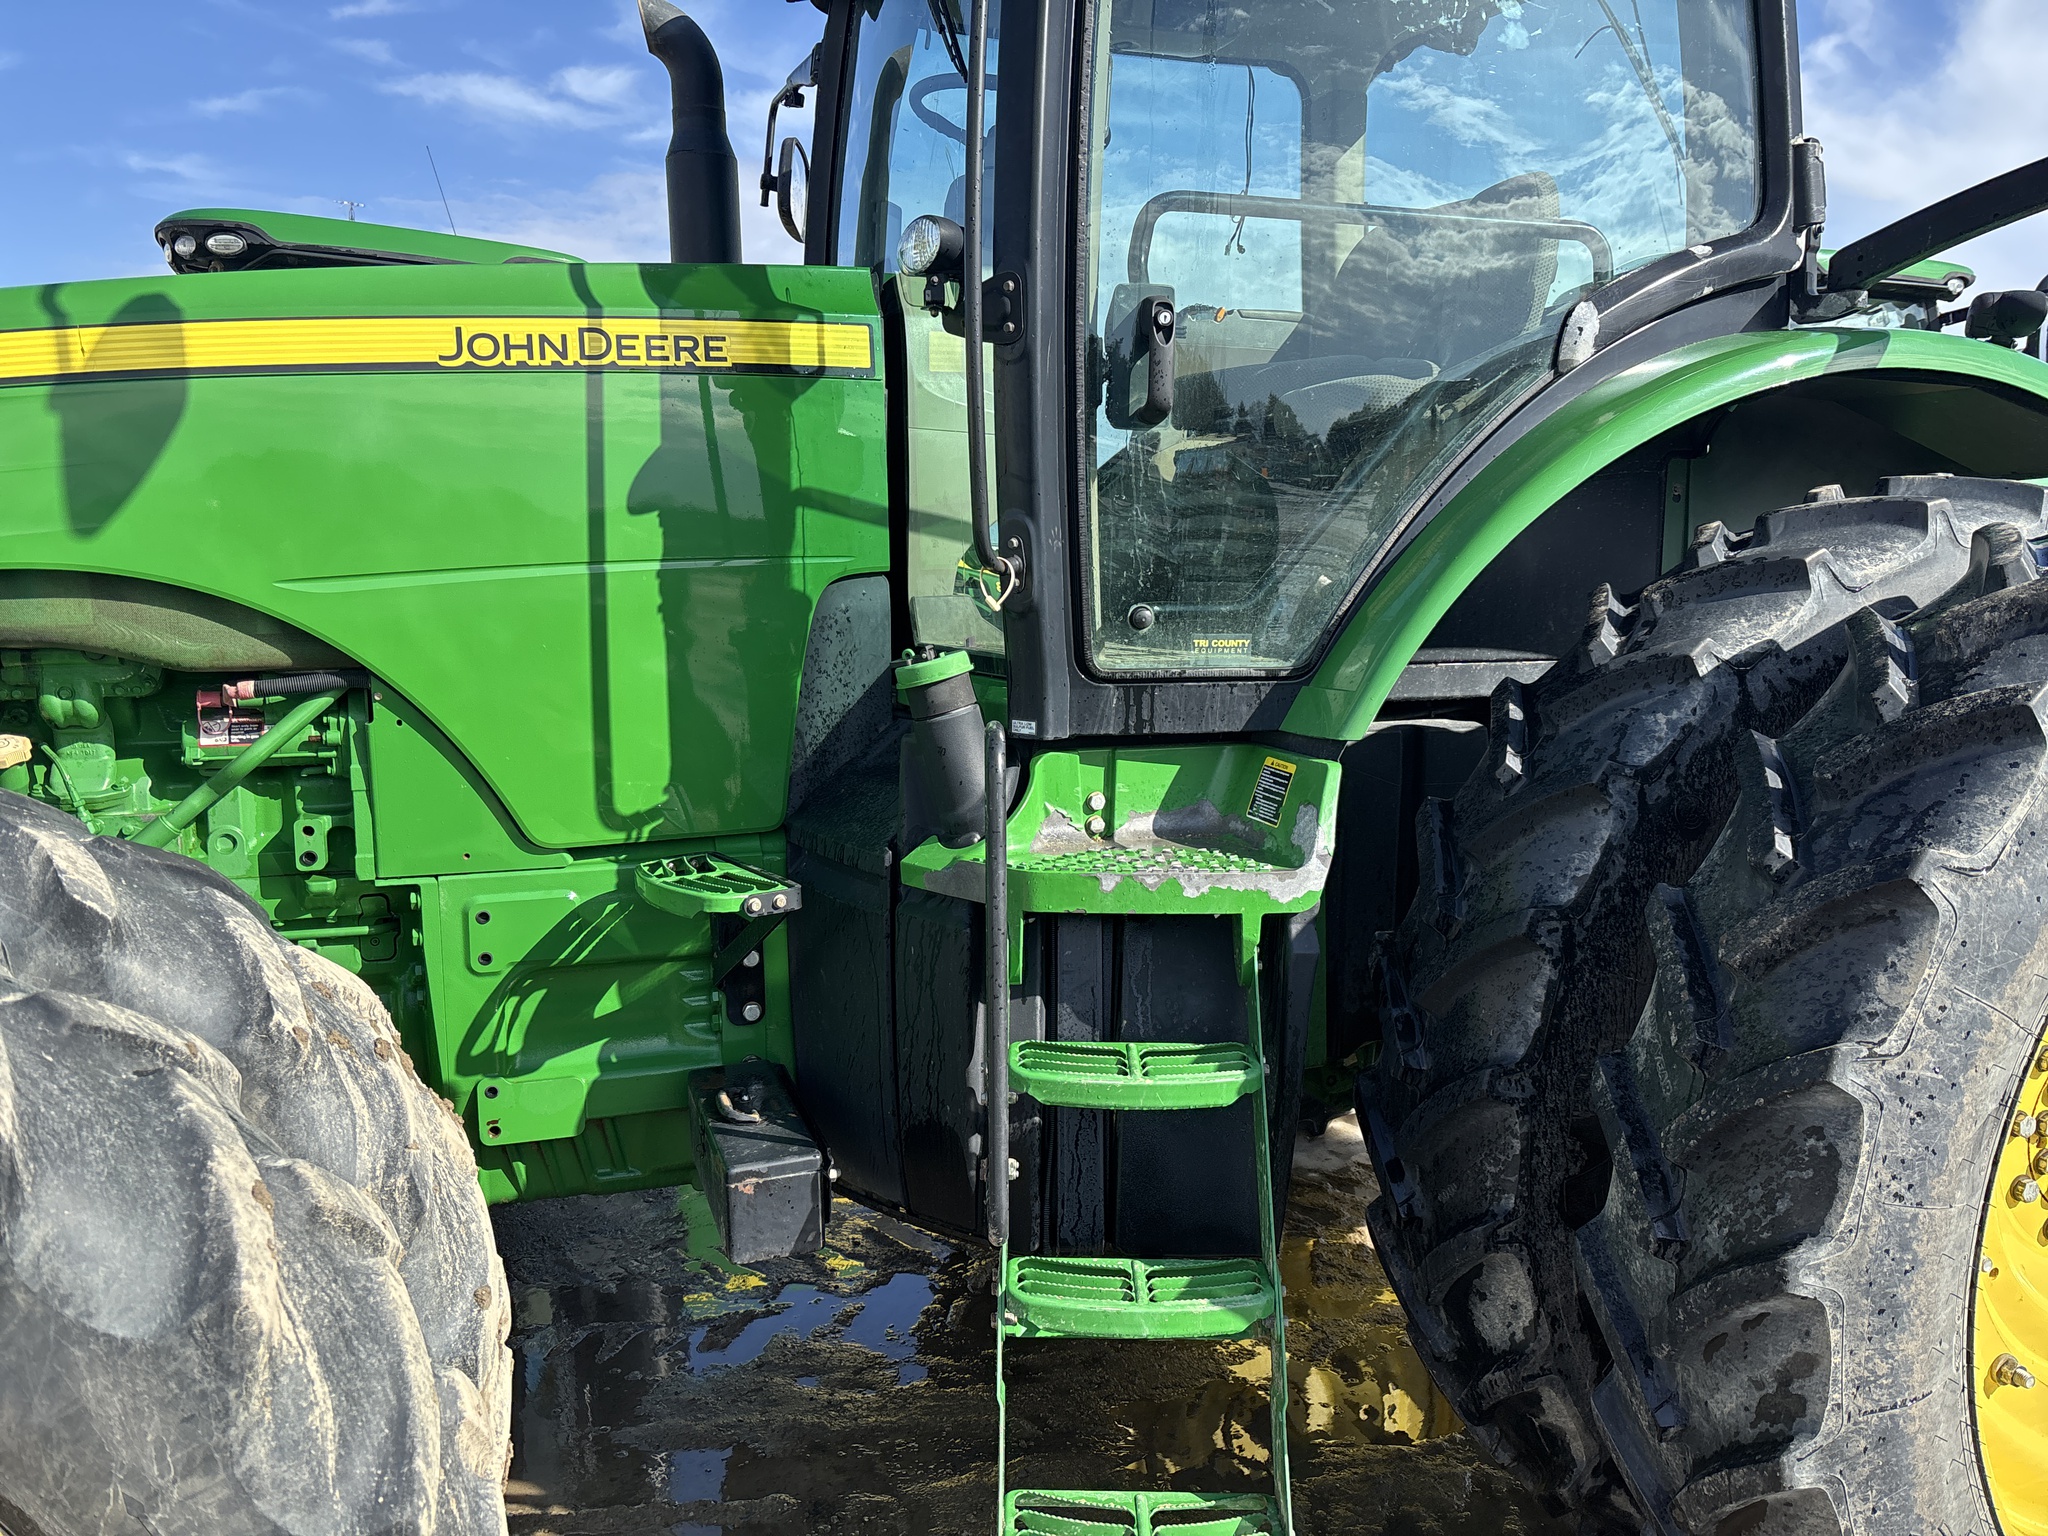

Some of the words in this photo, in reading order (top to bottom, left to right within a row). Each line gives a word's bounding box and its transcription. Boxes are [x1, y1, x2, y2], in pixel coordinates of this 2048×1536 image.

[438, 326, 569, 362] JOHN
[577, 326, 729, 363] DEERE
[1193, 639, 1209, 647] TRI
[1211, 639, 1250, 647] COUNTY
